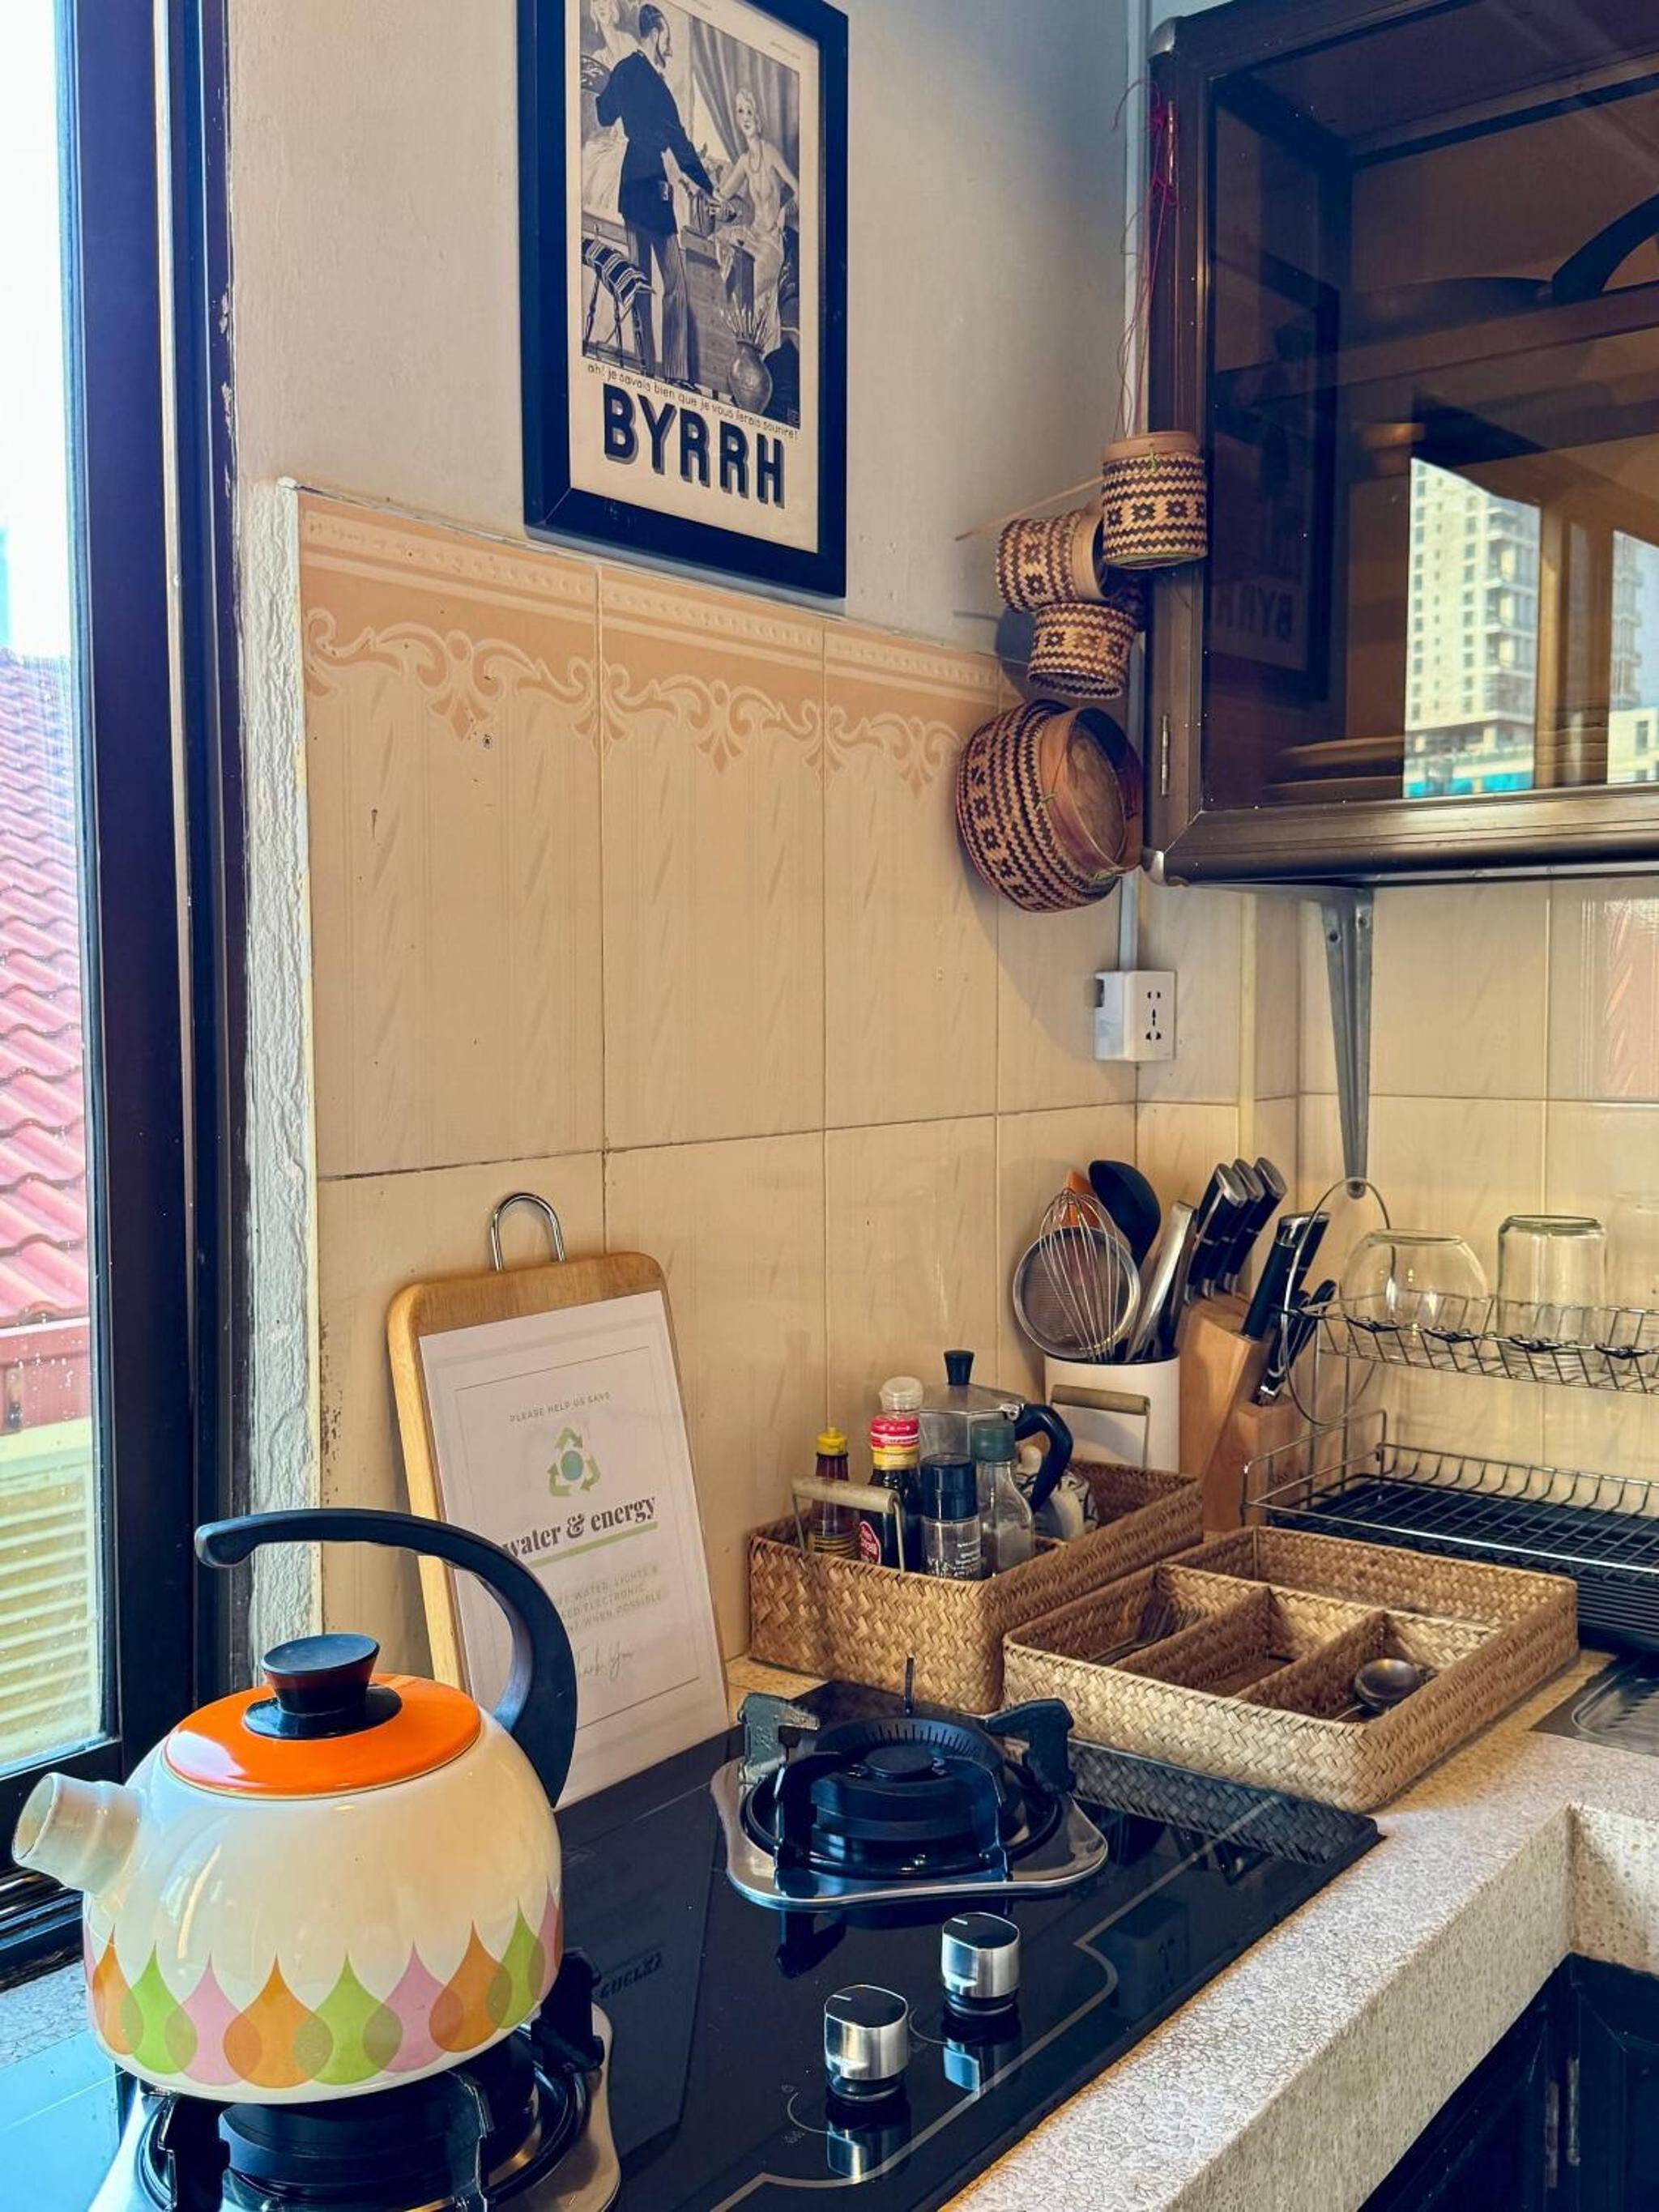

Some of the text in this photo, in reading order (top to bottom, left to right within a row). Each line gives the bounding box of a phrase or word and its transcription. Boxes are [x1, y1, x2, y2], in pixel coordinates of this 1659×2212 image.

[608, 369, 618, 382] je
[620, 374, 651, 392] savais
[654, 382, 676, 398] bien
[678, 393, 697, 407] que
[700, 398, 710, 411] je
[712, 405, 735, 420] vous
[603, 382, 786, 509] BYRRH
[502, 1496, 656, 1558] water & energy
